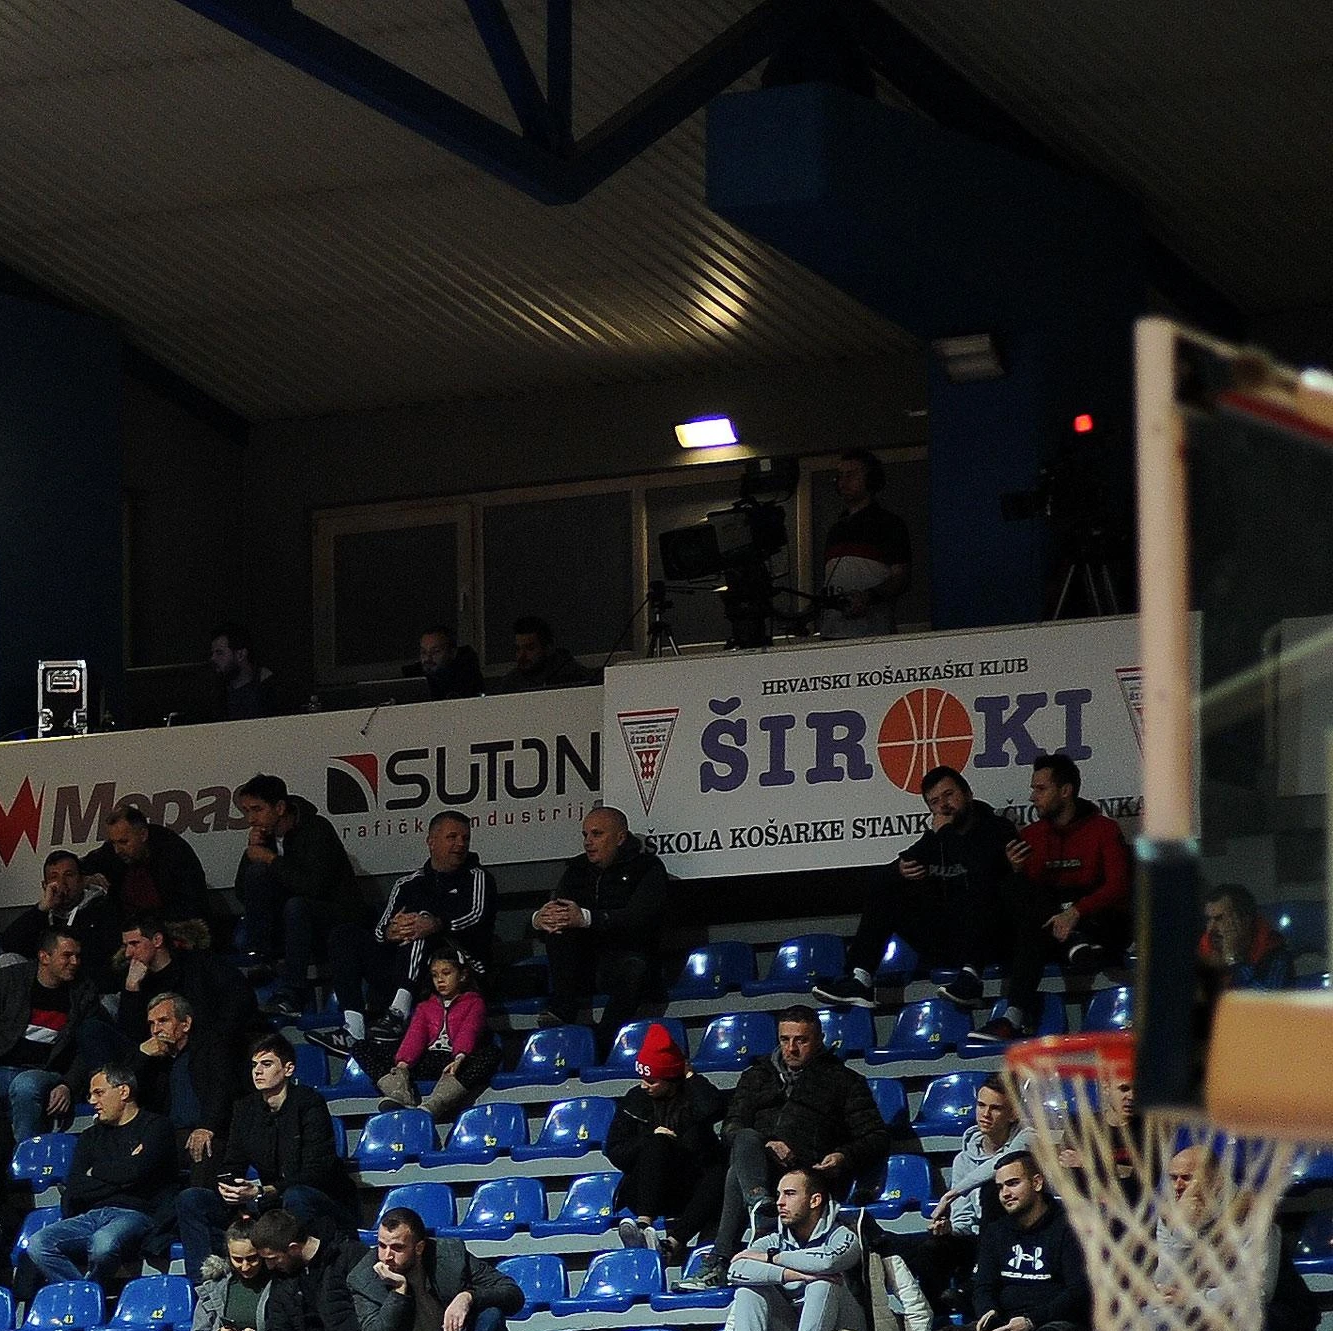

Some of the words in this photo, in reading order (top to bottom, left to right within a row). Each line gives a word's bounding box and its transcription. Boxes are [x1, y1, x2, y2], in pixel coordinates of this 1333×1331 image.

[762, 673, 851, 696] HRVATSKI
[856, 659, 974, 687] KOŠARKAŠKI
[979, 657, 1029, 677] KLUB
[386, 732, 601, 811] SUTON
[342, 816, 424, 840] rafičk
[470, 800, 585, 829] ndustrij
[644, 829, 723, 856] ŠKOLA
[729, 818, 845, 850] KOŠARKE
[852, 812, 931, 840] STANK
